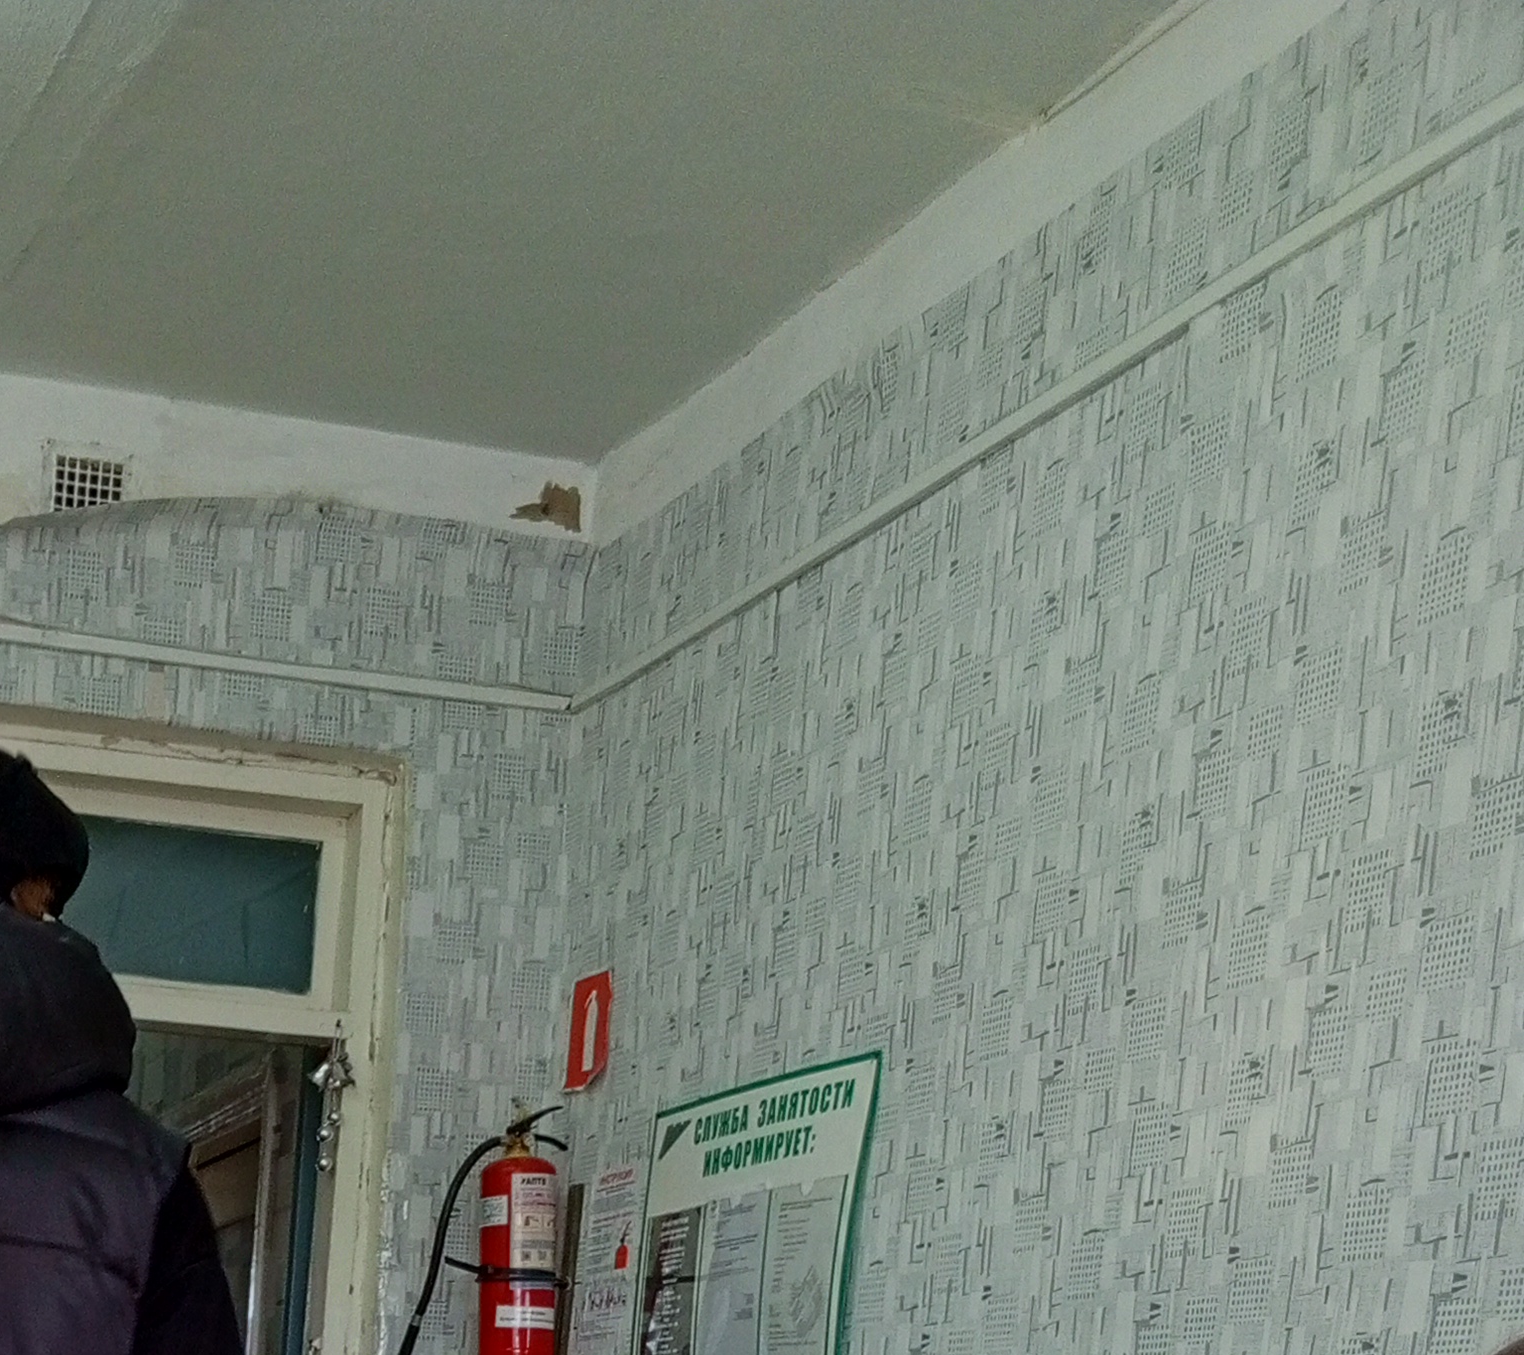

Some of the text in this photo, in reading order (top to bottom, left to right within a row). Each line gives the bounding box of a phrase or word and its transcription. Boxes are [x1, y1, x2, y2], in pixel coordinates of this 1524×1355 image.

[694, 1078, 856, 1145] СЛУЖБА ЗАНЯТОСТИ
[702, 1125, 817, 1178] ИНФОРМИРУЕТ:
